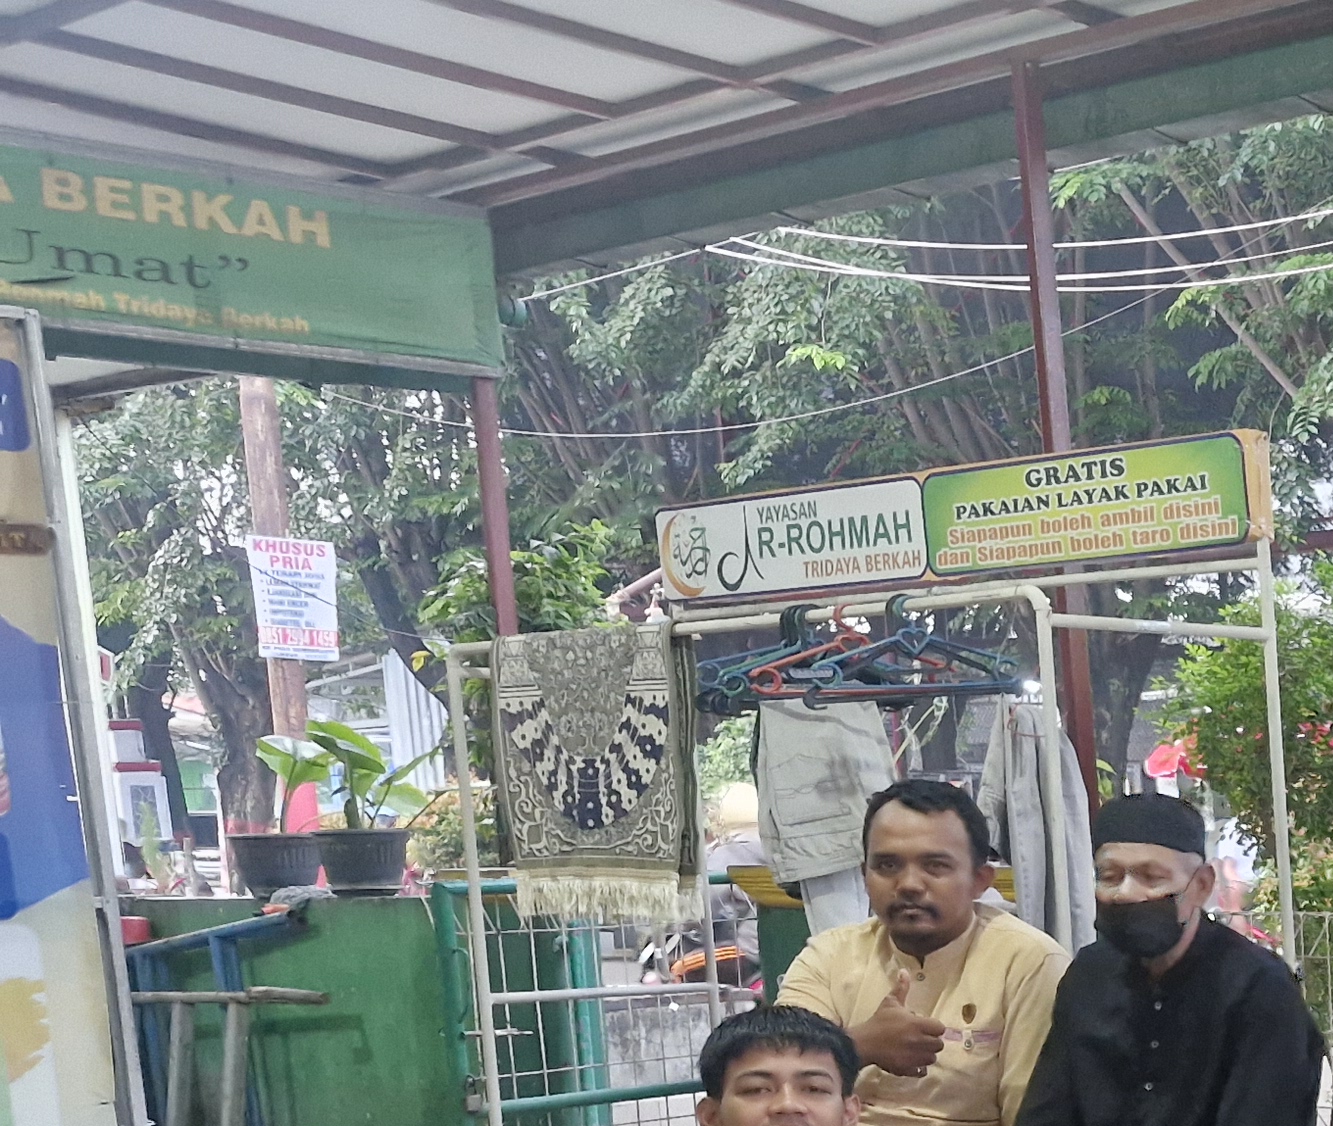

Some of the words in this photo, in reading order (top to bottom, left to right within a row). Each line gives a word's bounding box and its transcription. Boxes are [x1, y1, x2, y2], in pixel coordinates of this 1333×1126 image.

[41, 167, 332, 249] BERKAH
[1024, 457, 1126, 488] GRATIS
[756, 500, 818, 524] YAYASAN
[955, 494, 1051, 520] PAKAIAN
[1056, 484, 1131, 508] LAYAK
[1136, 474, 1209, 499] PAKAI
[948, 520, 1033, 547] Siapapun
[1040, 513, 1093, 535] boleh
[1100, 505, 1156, 528] ambil
[1163, 498, 1221, 521] disini
[252, 538, 326, 557] KHUSUS
[937, 548, 971, 567] dan
[977, 539, 1063, 564] Siapapun
[1069, 531, 1125, 553] boleh
[1132, 527, 1172, 546] taro
[1179, 517, 1239, 541] disini
[269, 554, 313, 571] PRIA
[803, 556, 861, 579] TRIDAYA
[865, 550, 922, 571] BERKAH
